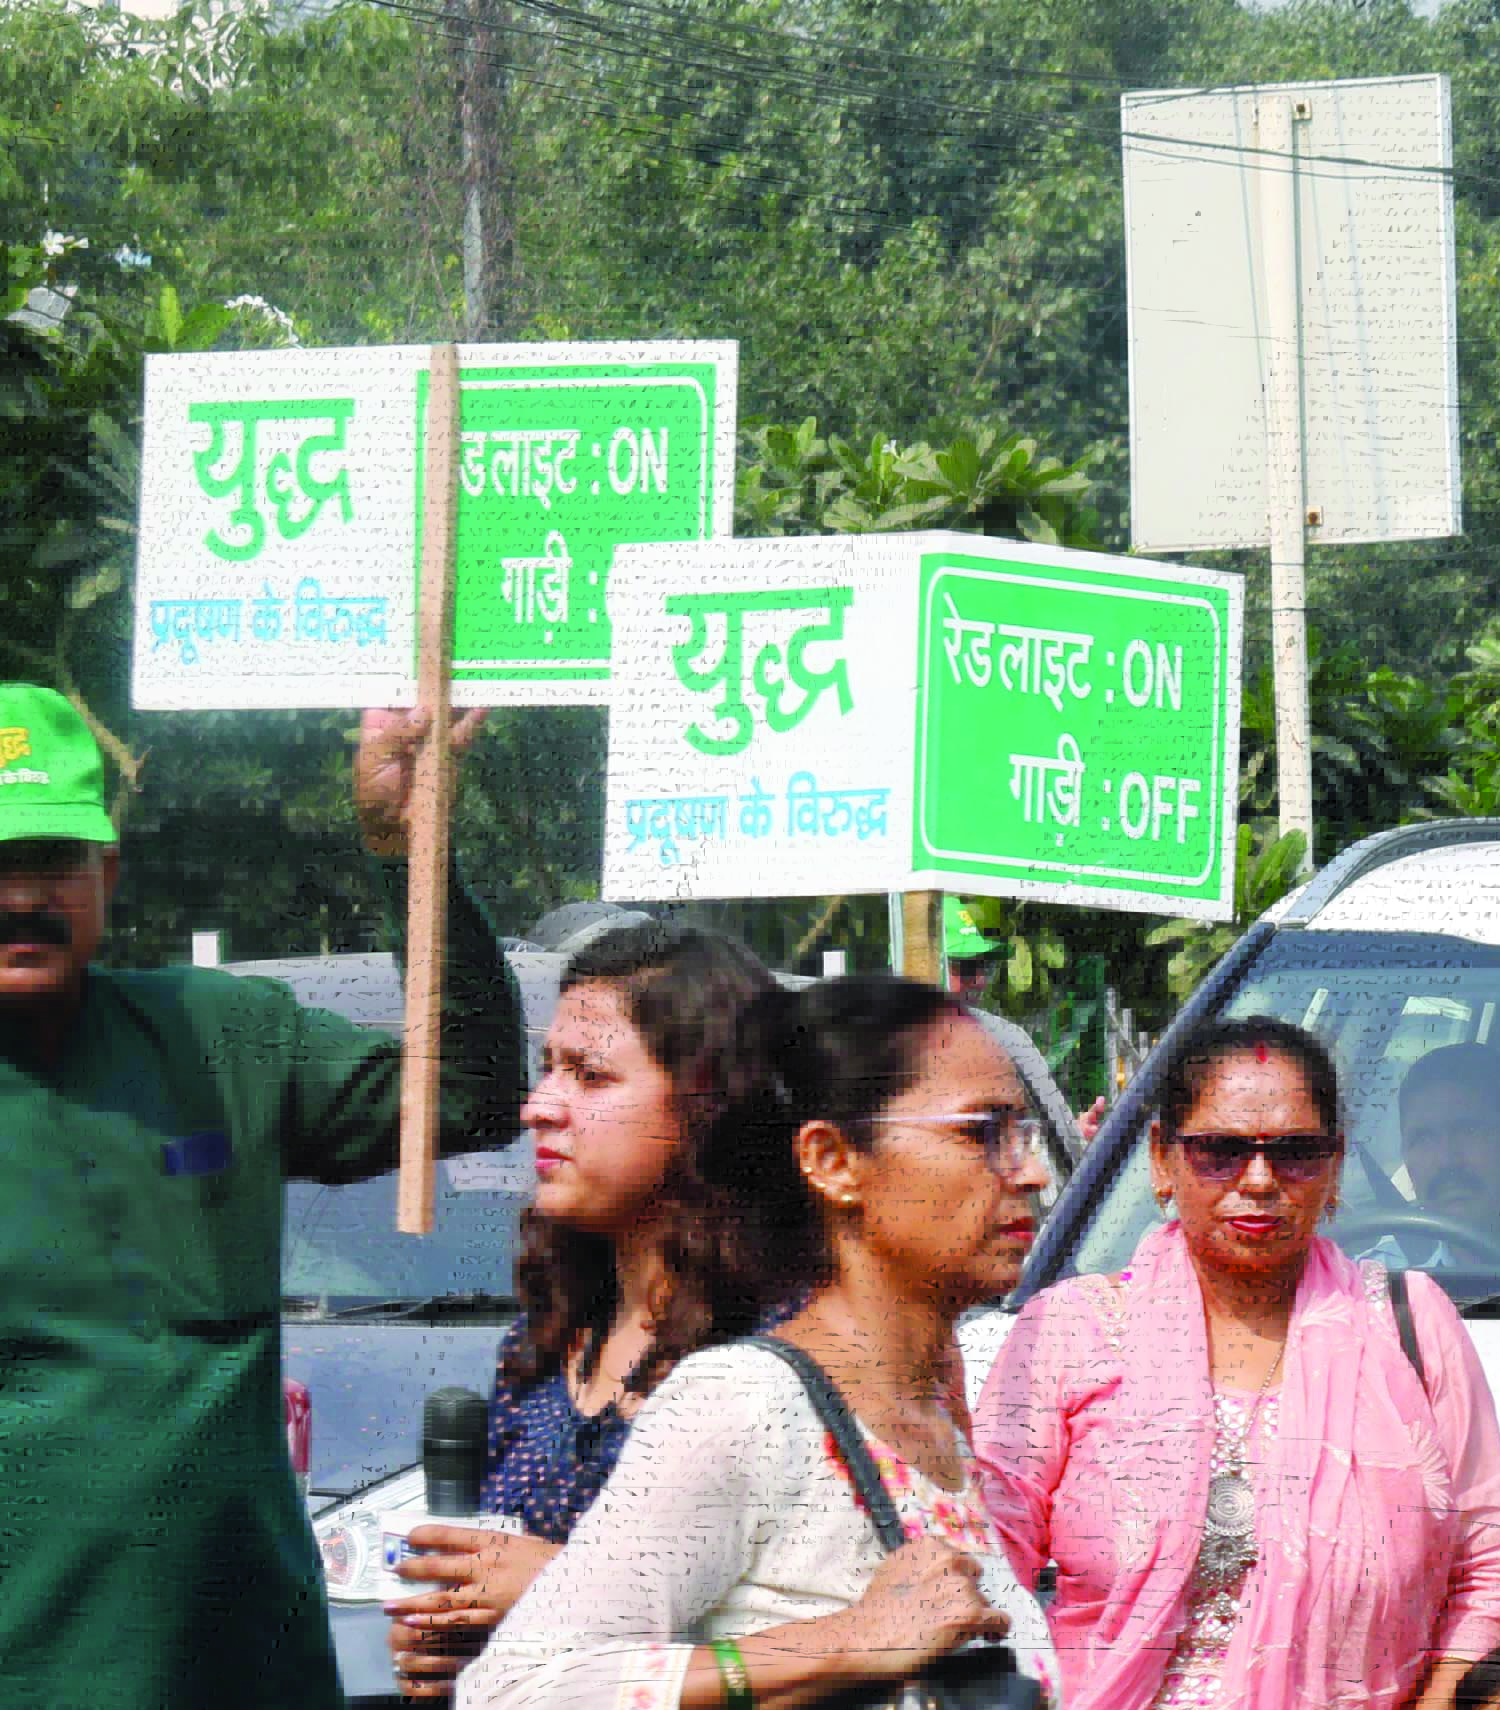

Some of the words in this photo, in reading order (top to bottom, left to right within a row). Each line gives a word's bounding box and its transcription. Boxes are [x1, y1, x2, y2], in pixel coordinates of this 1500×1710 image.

[188, 398, 354, 561] युद्ध
[252, 584, 285, 640] के
[501, 531, 572, 643] गाड़ी
[666, 587, 854, 755] युद्ध
[740, 778, 775, 838] के
[787, 772, 891, 840] विरुद्ध
[1010, 734, 1085, 846] गाड़ी
